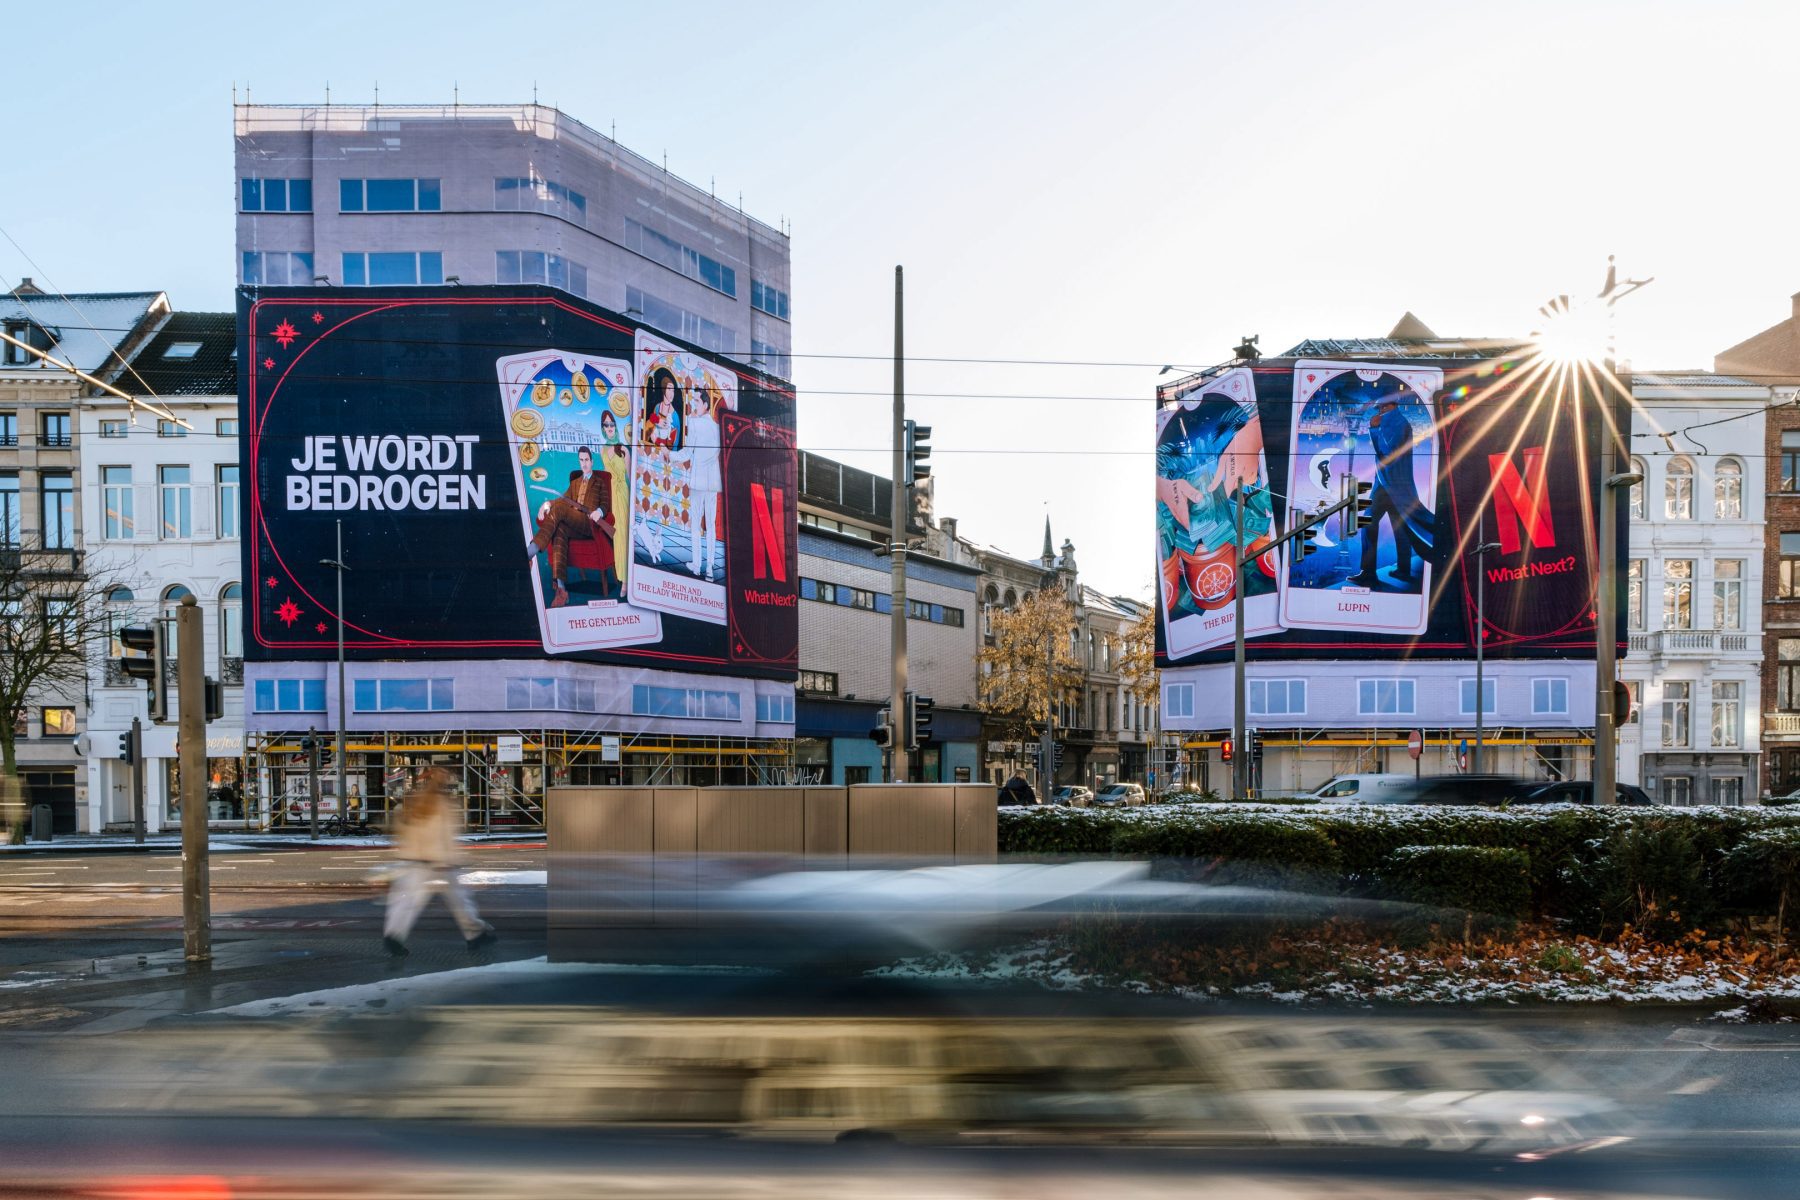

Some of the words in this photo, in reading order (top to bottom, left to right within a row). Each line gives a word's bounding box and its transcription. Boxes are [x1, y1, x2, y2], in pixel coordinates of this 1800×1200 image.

[291, 435, 336, 471] JE
[341, 434, 480, 471] WORDT
[286, 474, 486, 511] BEDROGEN
[1487, 564, 1529, 583] What
[1530, 556, 1575, 576] Next?
[637, 582, 652, 593] THE
[653, 587, 670, 598] LADY
[671, 591, 689, 602] WITH
[690, 596, 700, 604] AN
[700, 599, 725, 610] ERMINE
[662, 580, 687, 594] BERLIN
[688, 587, 702, 597] AND
[744, 589, 770, 605] What
[770, 592, 797, 607] Next?
[1338, 603, 1370, 613] LUPIN
[569, 618, 588, 629] THE
[588, 615, 640, 627] GENTLEMEN
[1203, 617, 1220, 630] THE
[1221, 612, 1235, 625] RIP
